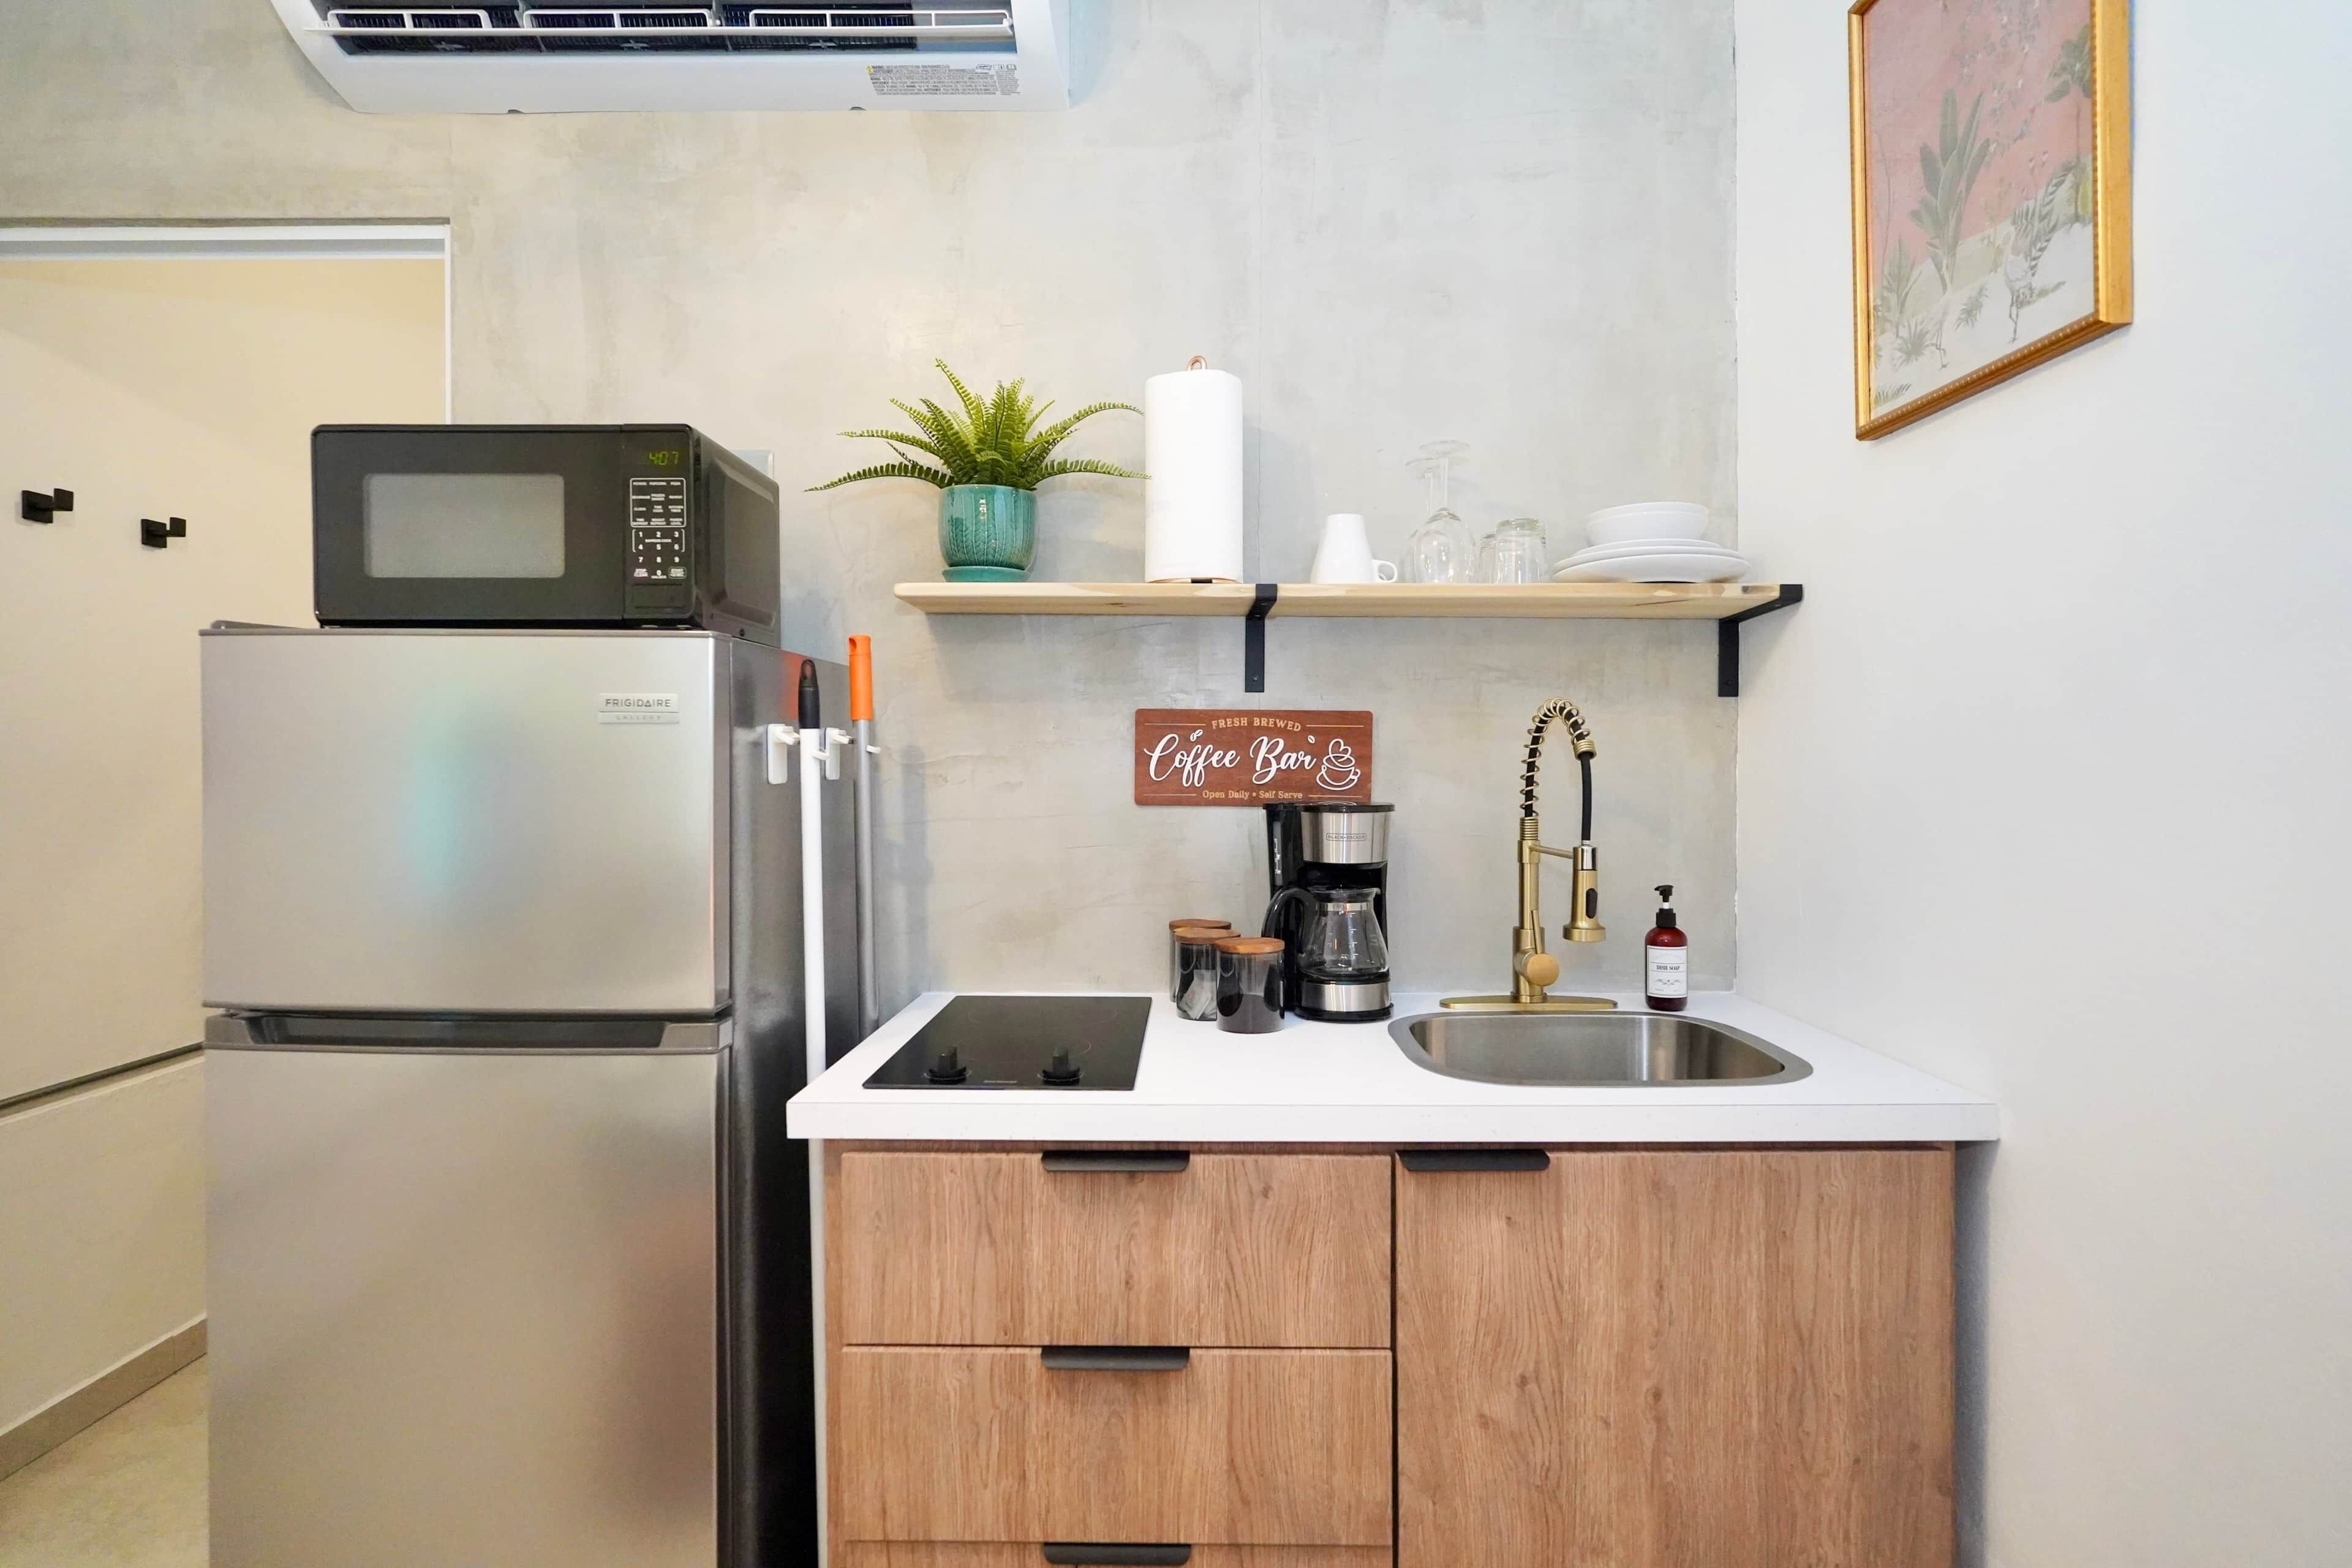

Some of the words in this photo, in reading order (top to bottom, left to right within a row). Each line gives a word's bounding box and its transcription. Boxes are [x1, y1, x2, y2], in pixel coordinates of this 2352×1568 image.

[1212, 717, 1248, 729] FRESH
[1253, 717, 1301, 731] BREWED
[1144, 734, 1240, 787] Coffee
[1250, 736, 1317, 785] Bar
[1202, 790, 1225, 799] Open
[1228, 790, 1250, 800] Daily
[1259, 790, 1276, 799] Self
